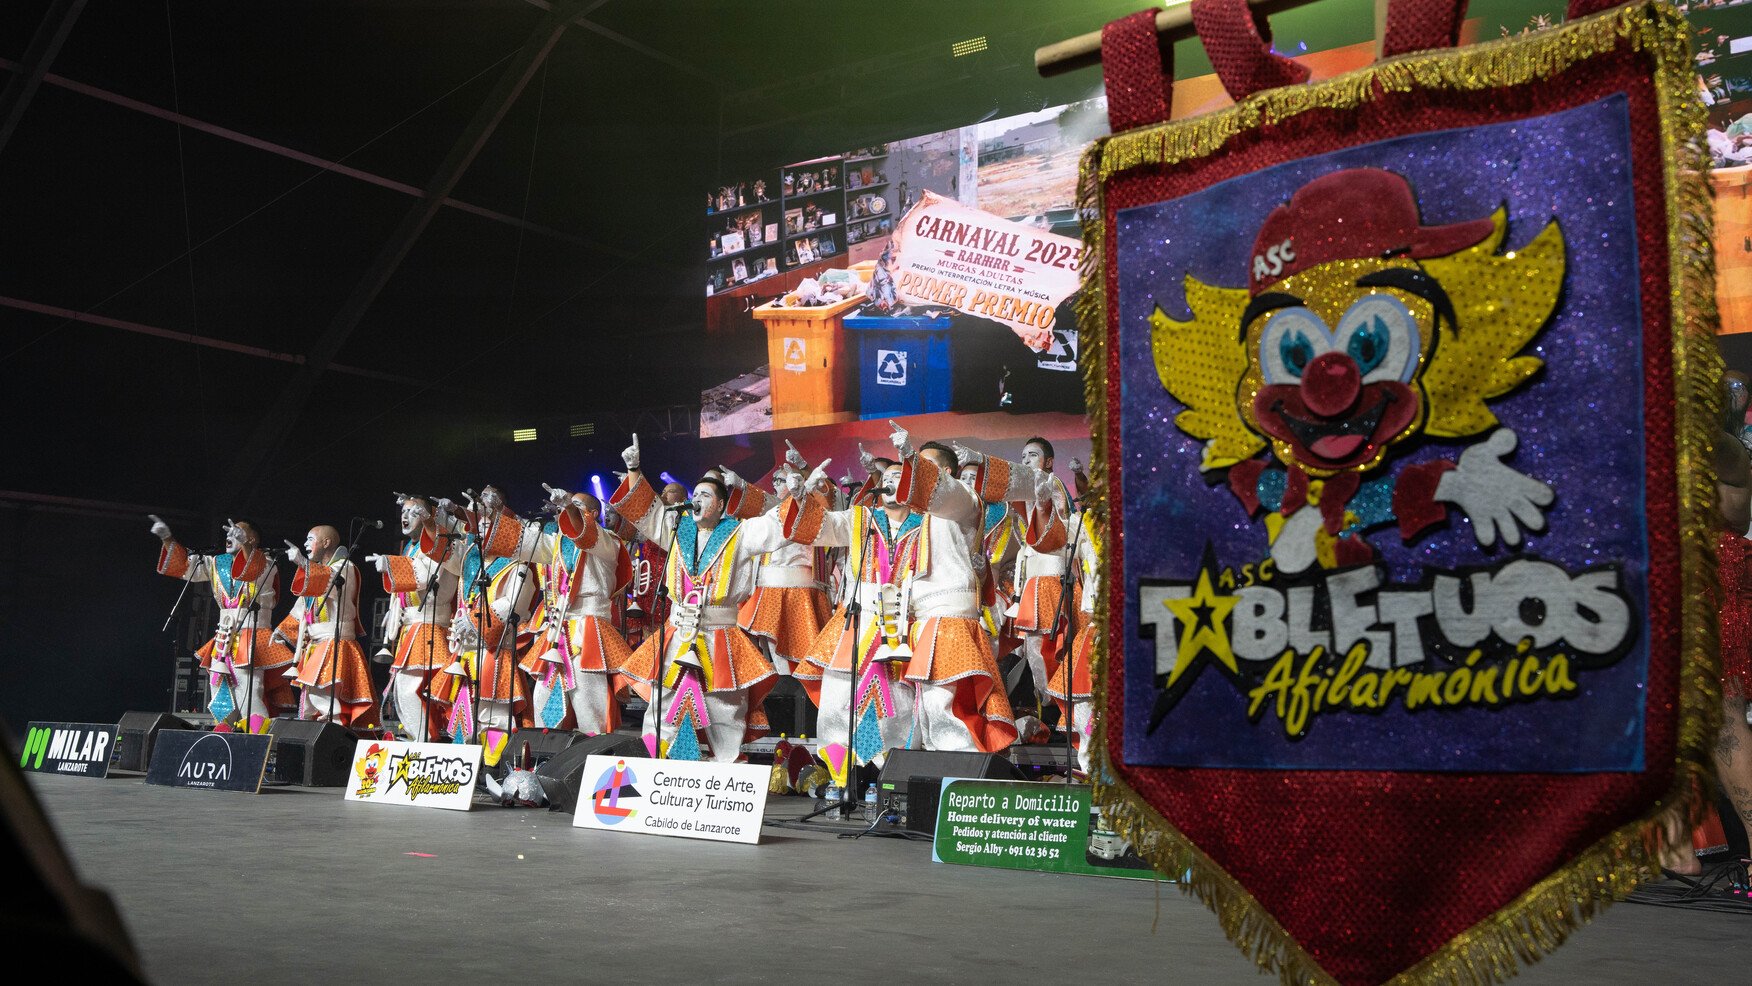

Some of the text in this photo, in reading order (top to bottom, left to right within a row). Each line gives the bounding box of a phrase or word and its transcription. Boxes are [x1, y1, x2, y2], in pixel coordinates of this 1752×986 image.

[915, 214, 1021, 257] CARNAVAL
[936, 259, 1024, 285] MURGAS ADULTAS
[1253, 239, 1296, 281] ASC
[911, 262, 936, 274] PREMIO
[937, 268, 993, 287] INTERPRETACIÓN
[994, 282, 1015, 293] LETRA
[1024, 289, 1050, 301] MÚSICA
[900, 270, 1055, 329] PRIMER PREMIO
[1219, 557, 1274, 588] ASC
[1248, 638, 1577, 736] Afilarmónica
[47, 729, 110, 762] MILAR
[57, 762, 88, 773] LANZAROTE
[179, 761, 229, 781] AURA
[653, 771, 756, 795] Centros de Arte,
[649, 790, 754, 813] Cultura y Turismo
[948, 791, 1080, 813] Reparto a Domicilio
[644, 815, 741, 836] Cabildo de Lanzarote
[947, 811, 1077, 829] Home delivery of water
[952, 825, 1067, 843] Pedidos y atención al cliente
[956, 840, 982, 855] Sergio
[983, 842, 1004, 857] Alby
[1009, 844, 1023, 857] 691
[1025, 845, 1036, 857] 62
[1037, 846, 1047, 859] 36
[1049, 847, 1060, 859] 52
